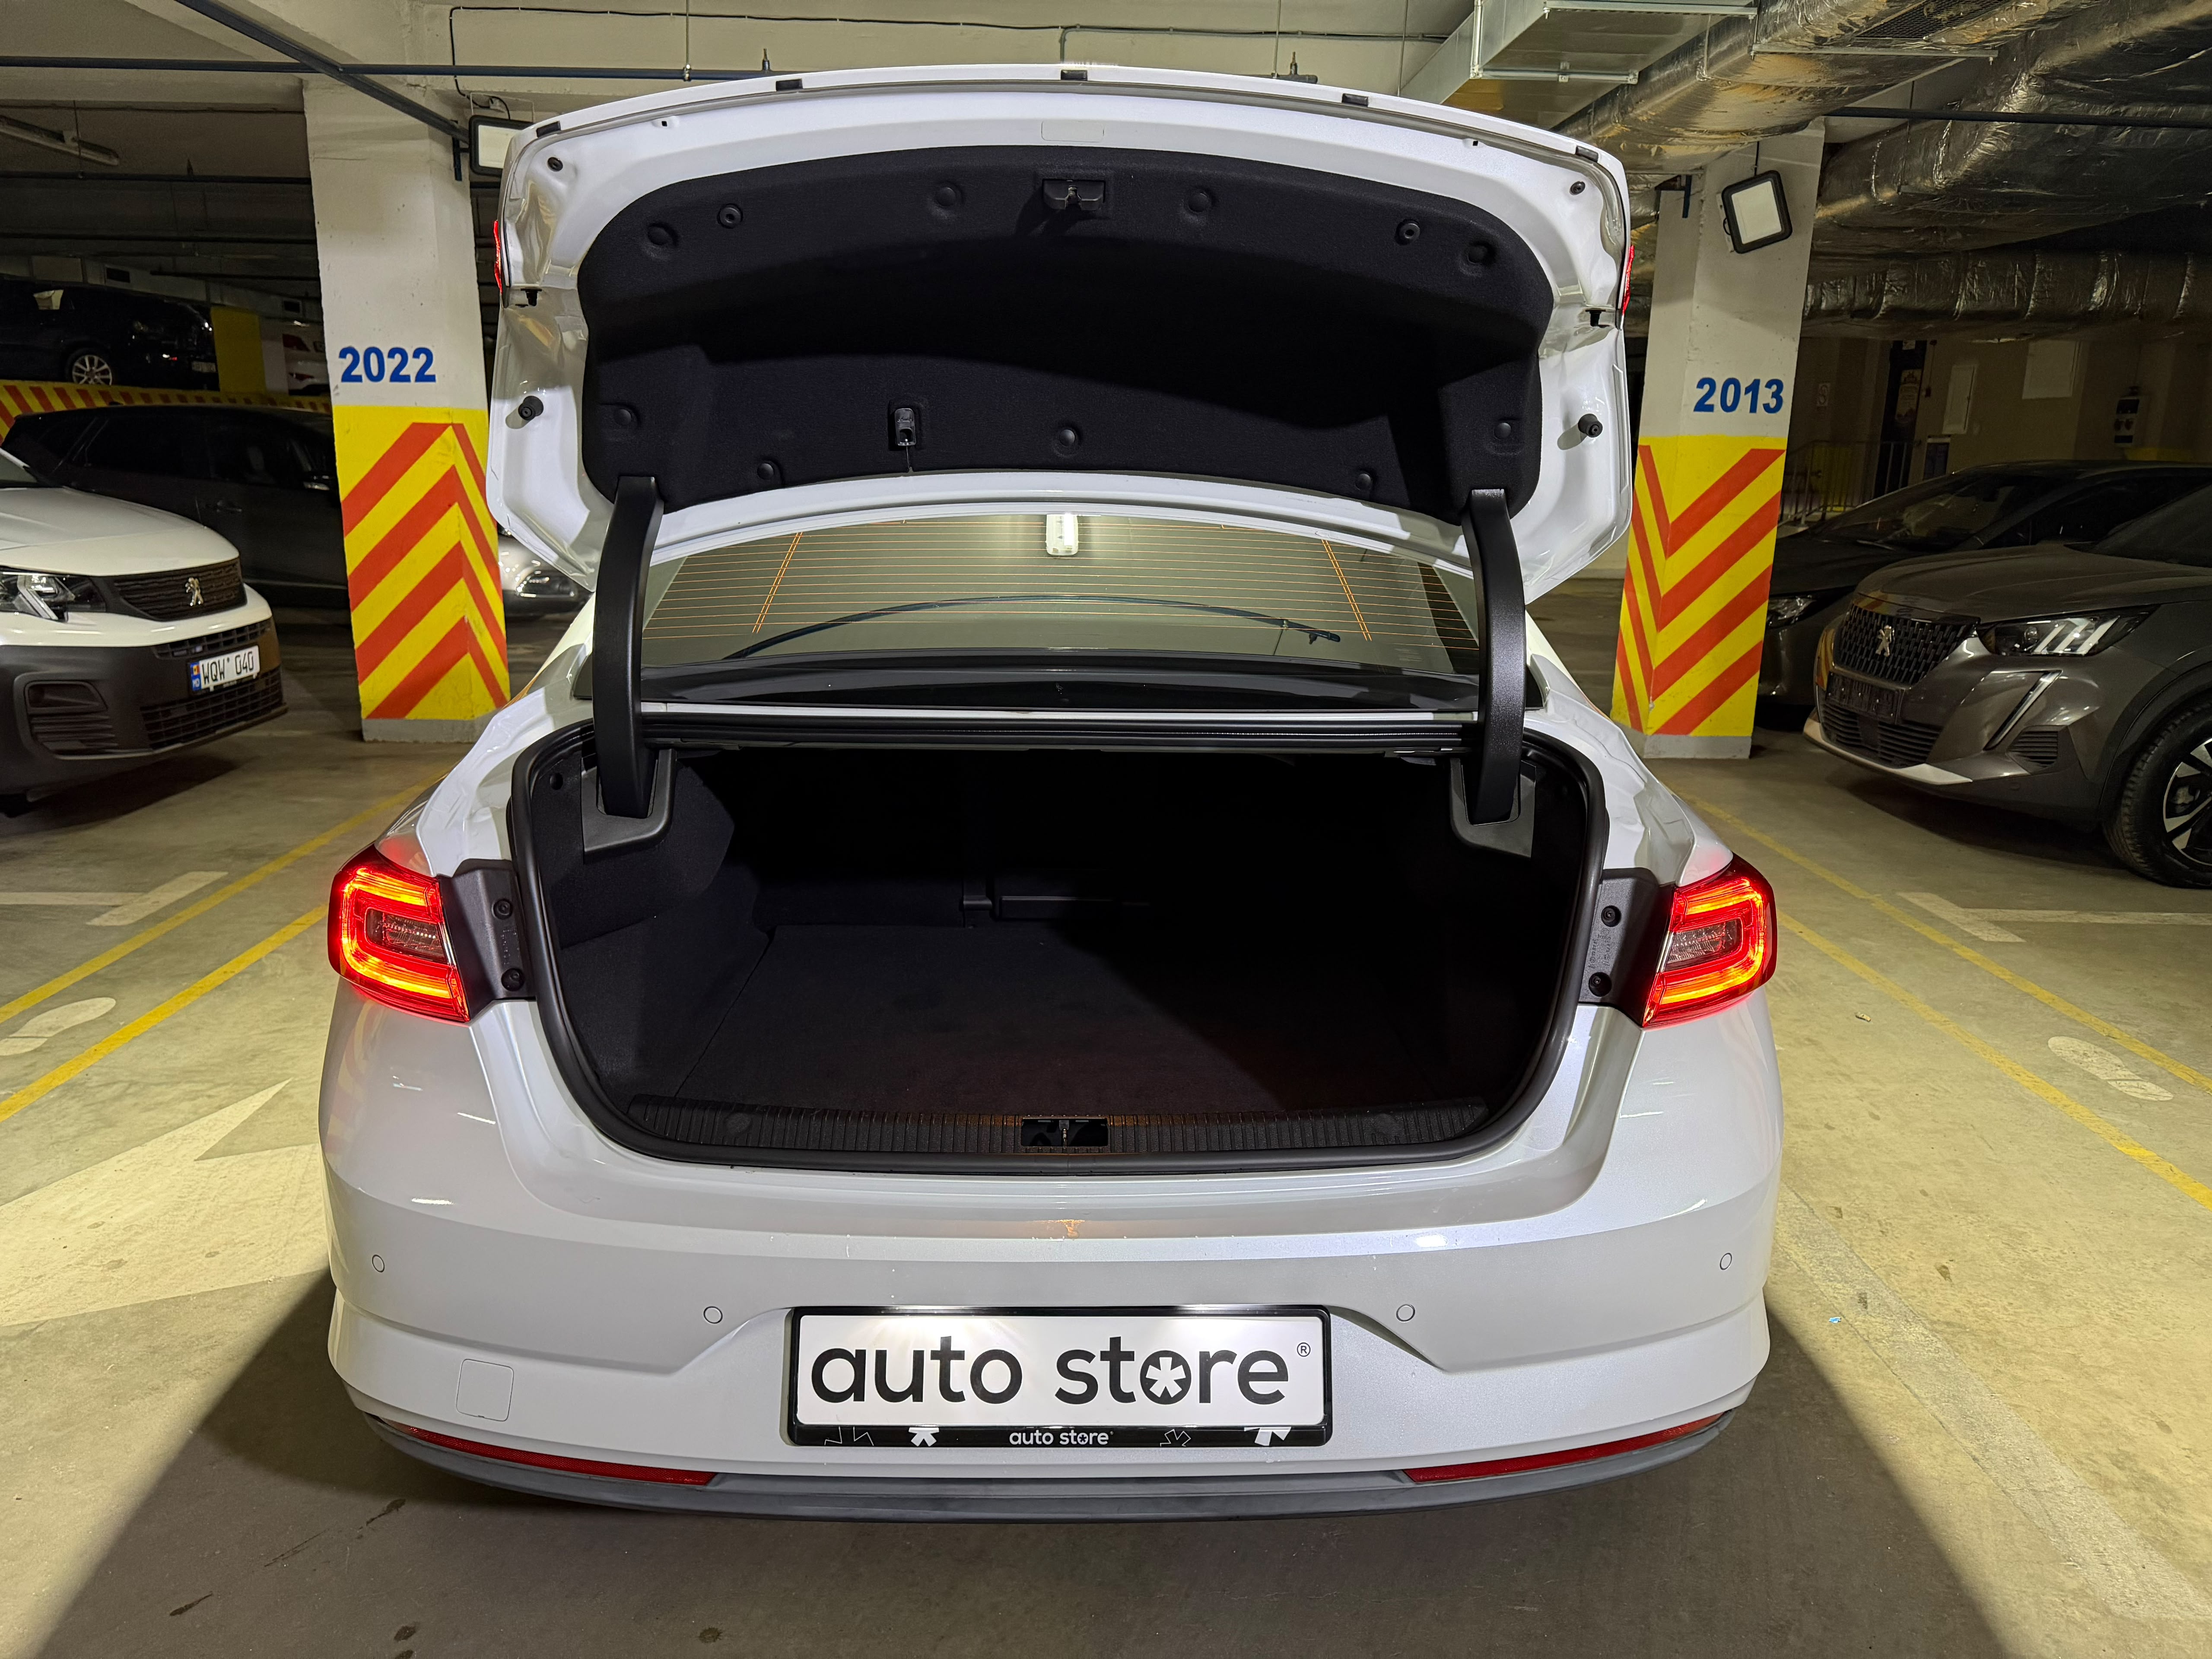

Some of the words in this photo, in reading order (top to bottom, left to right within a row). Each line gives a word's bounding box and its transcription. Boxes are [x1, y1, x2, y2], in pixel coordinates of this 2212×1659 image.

[339, 346, 436, 383] 2022
[1693, 377, 1784, 414] 2013
[202, 658, 225, 685] WQW
[235, 651, 254, 675] 040
[811, 1336, 1022, 1404] auto
[1009, 1430, 1054, 1445] auto
